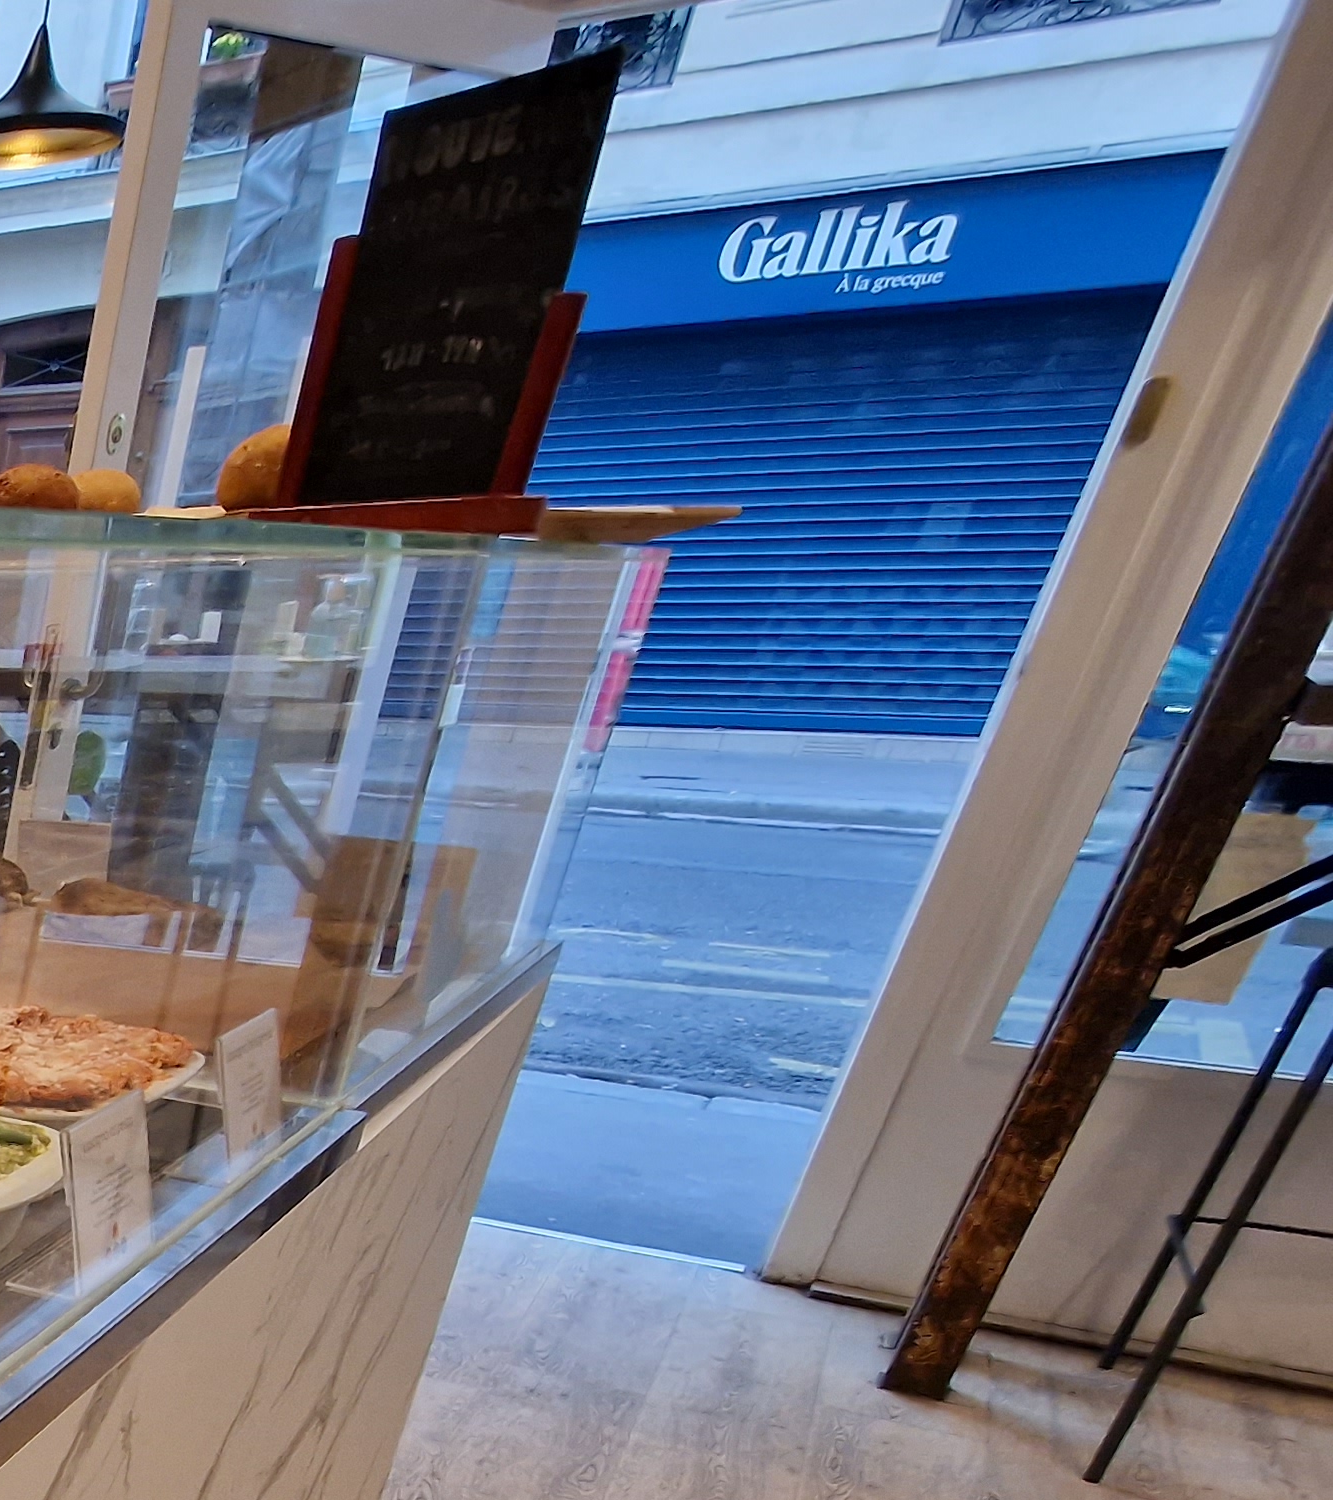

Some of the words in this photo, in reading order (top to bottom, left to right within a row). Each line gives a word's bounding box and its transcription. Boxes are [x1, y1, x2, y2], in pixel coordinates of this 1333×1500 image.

[718, 200, 959, 284] Gallika
[835, 272, 850, 294] À
[853, 274, 870, 293] la
[870, 270, 946, 295] grecque
